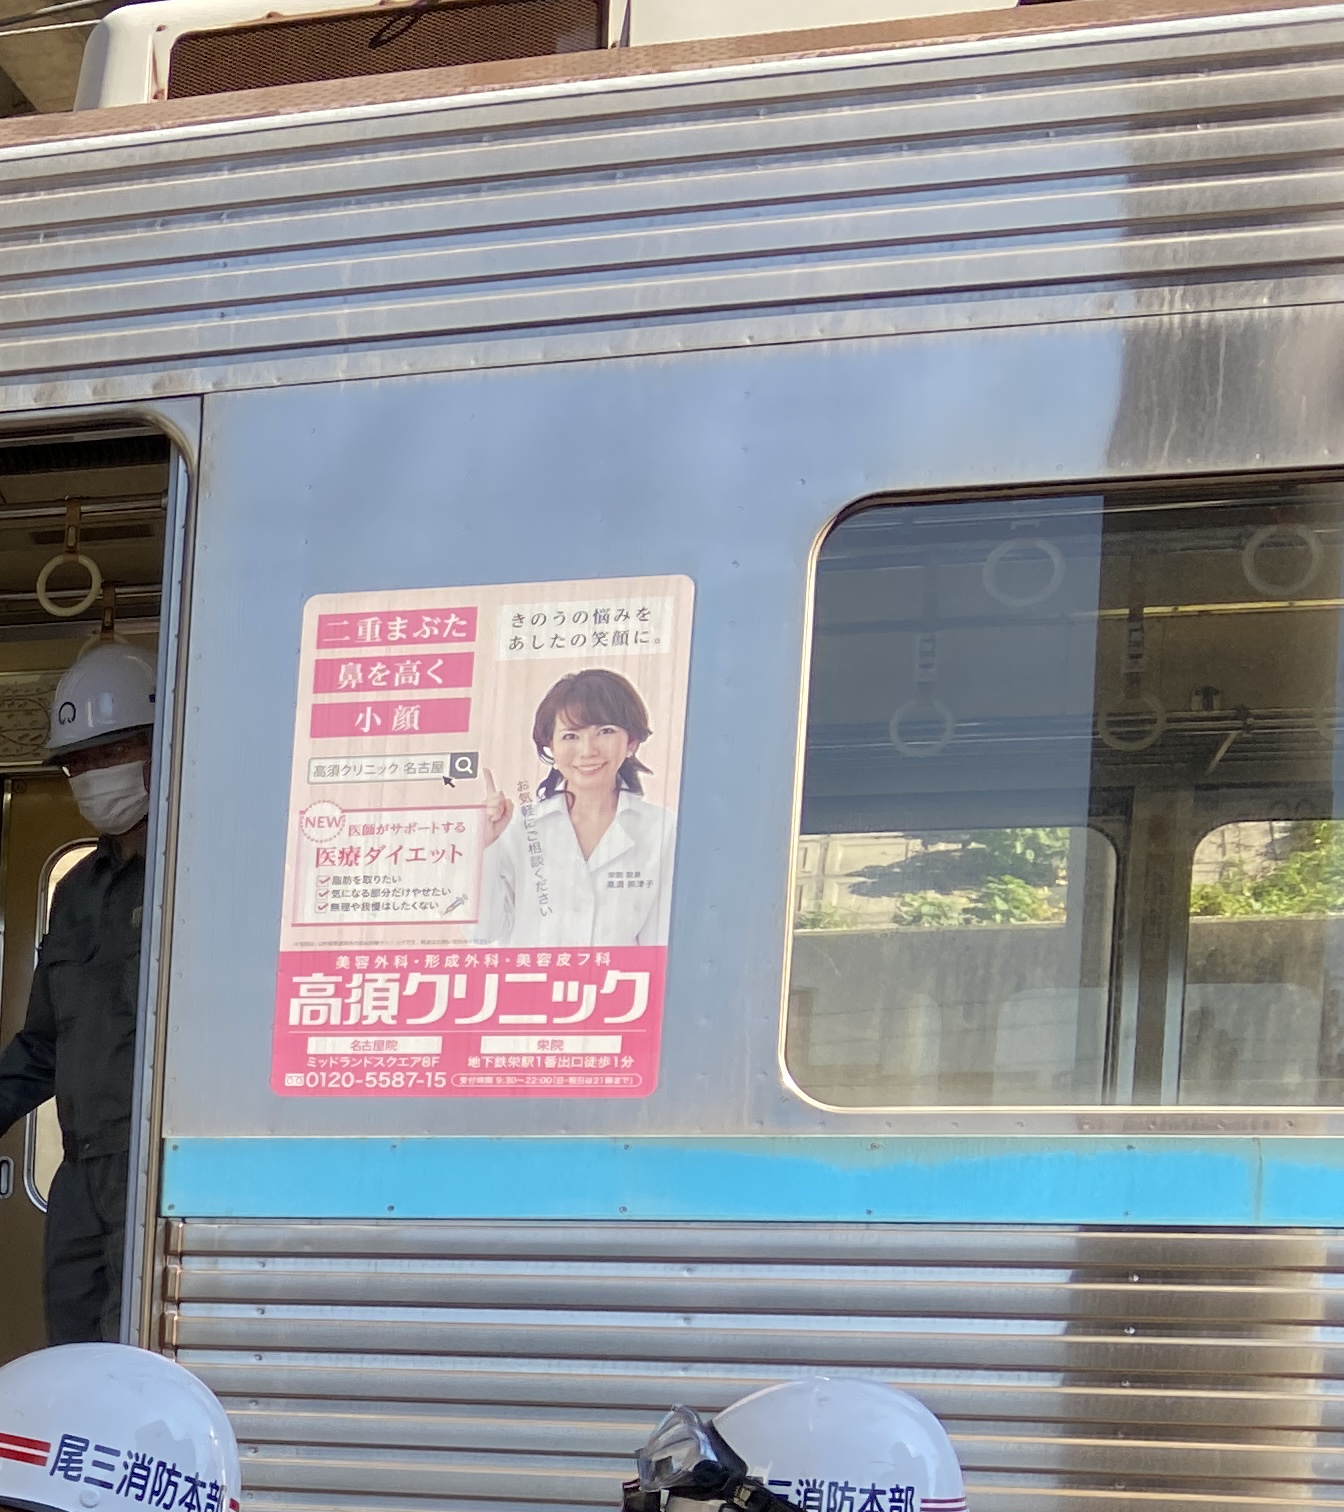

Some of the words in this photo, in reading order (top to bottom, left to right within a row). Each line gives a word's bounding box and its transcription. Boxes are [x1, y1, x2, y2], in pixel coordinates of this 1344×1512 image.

[511, 606, 652, 629] きのうの悩みを
[322, 612, 468, 644] 二重まぶた
[508, 629, 662, 651] あしたの笑顔に。
[336, 658, 445, 690] 鼻を高く
[354, 703, 422, 734] 小顔
[313, 762, 400, 778] 高須クリニック
[403, 760, 445, 775] 名古屋
[304, 815, 342, 829] NEW
[348, 821, 466, 837] 医師がサポートする
[314, 843, 464, 869] 医療ダイエット
[516, 779, 554, 918] お気軽にご相談ください
[335, 951, 612, 970] 美容外科・形成外科・美容皮フ科
[287, 969, 652, 1026] 高須クリニック
[349, 1039, 400, 1052] 名古屋院
[536, 1039, 565, 1052] 栄院
[306, 1056, 442, 1068] ミッドランドスクエア8F
[305, 1071, 448, 1089] 0120-5587-15
